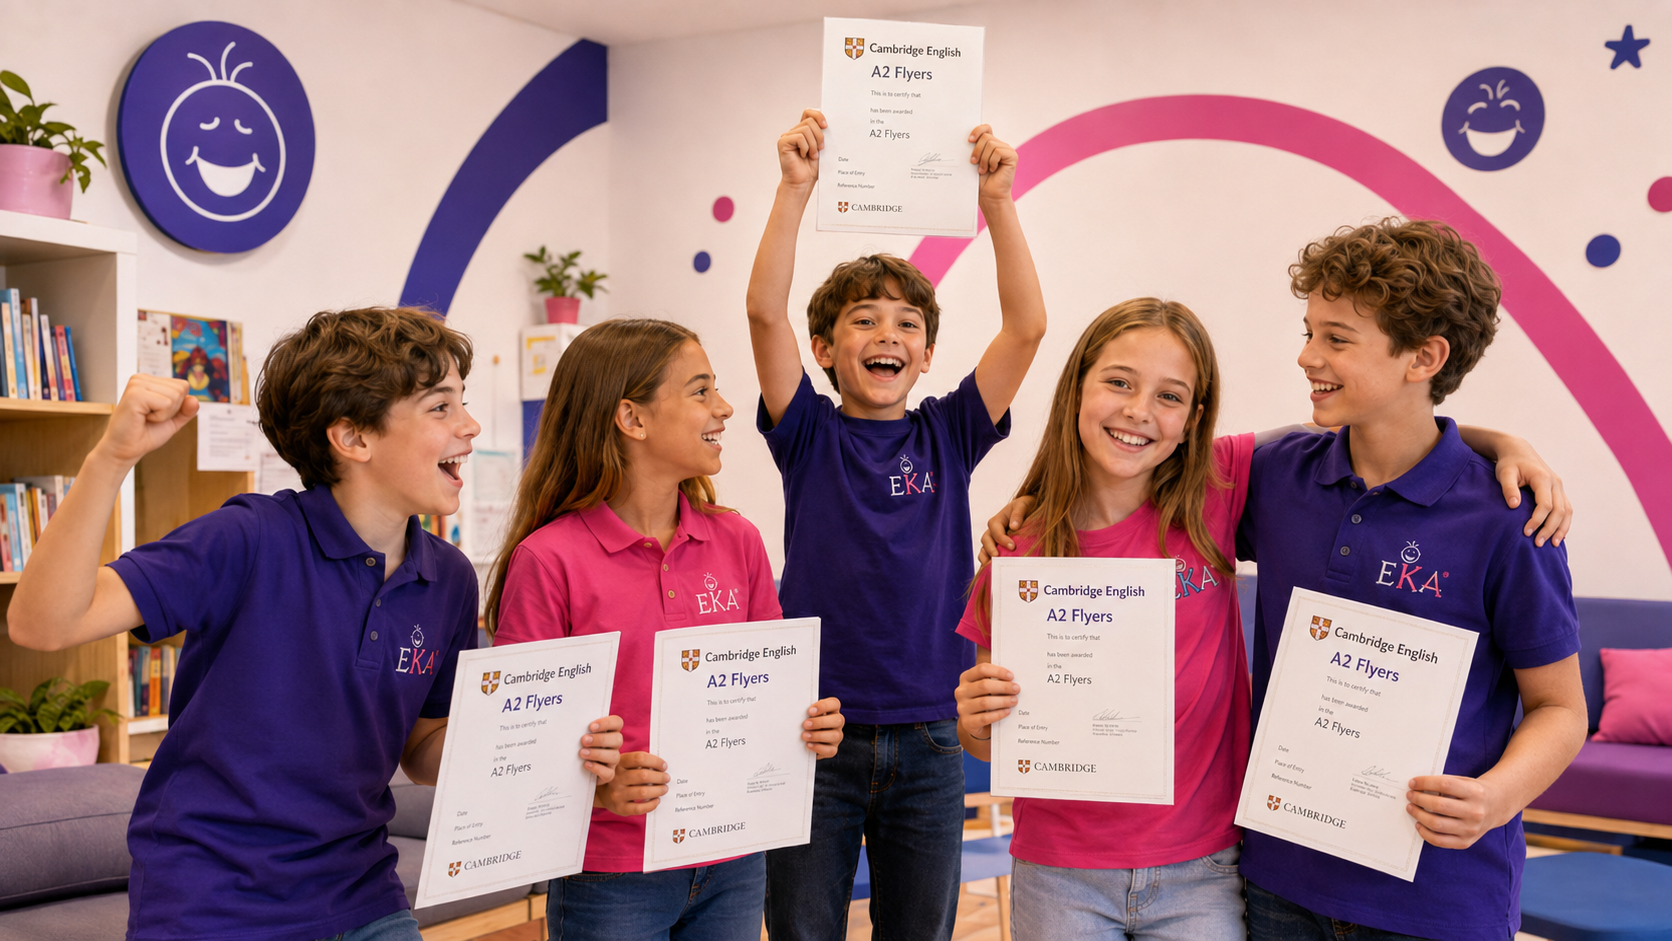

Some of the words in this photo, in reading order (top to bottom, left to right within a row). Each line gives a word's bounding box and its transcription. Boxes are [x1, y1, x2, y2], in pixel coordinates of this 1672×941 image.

[870, 43, 924, 57] Cambridge
[926, 46, 961, 59] English
[871, 65, 890, 78] A2
[895, 67, 933, 82] Flyers
[870, 130, 882, 138] A2
[885, 130, 910, 140] Flyers
[852, 204, 902, 212] CAMBRIDGE
[1175, 565, 1219, 600] KA
[1044, 585, 1102, 598] Cambridge
[1106, 586, 1145, 599] English
[1047, 608, 1066, 622] A2
[1072, 609, 1113, 625] Flyers
[1334, 626, 1395, 653] Cambridge
[1397, 644, 1438, 664] English
[705, 650, 760, 662] Cambridge
[763, 645, 796, 659] English
[504, 669, 555, 685] Cambridge
[558, 663, 592, 680] English
[1330, 652, 1351, 668] A2
[1356, 658, 1399, 682] Flyers
[707, 674, 726, 688] A2
[731, 672, 769, 688] Flyers
[1047, 674, 1060, 683] A2
[1064, 674, 1091, 686] Flyers
[1326, 676, 1337, 684] This
[1351, 683, 1369, 695] certify
[1370, 688, 1381, 697] that
[502, 697, 521, 713] A2
[526, 694, 563, 711] Flyers
[1321, 694, 1330, 703] has
[1325, 707, 1334, 715] the
[521, 721, 537, 730] certify
[1314, 717, 1328, 729] A2
[1332, 722, 1361, 738] Flyers
[705, 739, 717, 749] A2
[721, 737, 746, 748] Flyers
[491, 767, 503, 777] A2
[506, 764, 531, 775] Flyers
[1034, 762, 1097, 773] CAMBRIDGE
[1283, 802, 1346, 829] CAMBRIDGE
[689, 822, 746, 838] CAMBRIDGE
[464, 851, 522, 870] CAMBRIDGE
